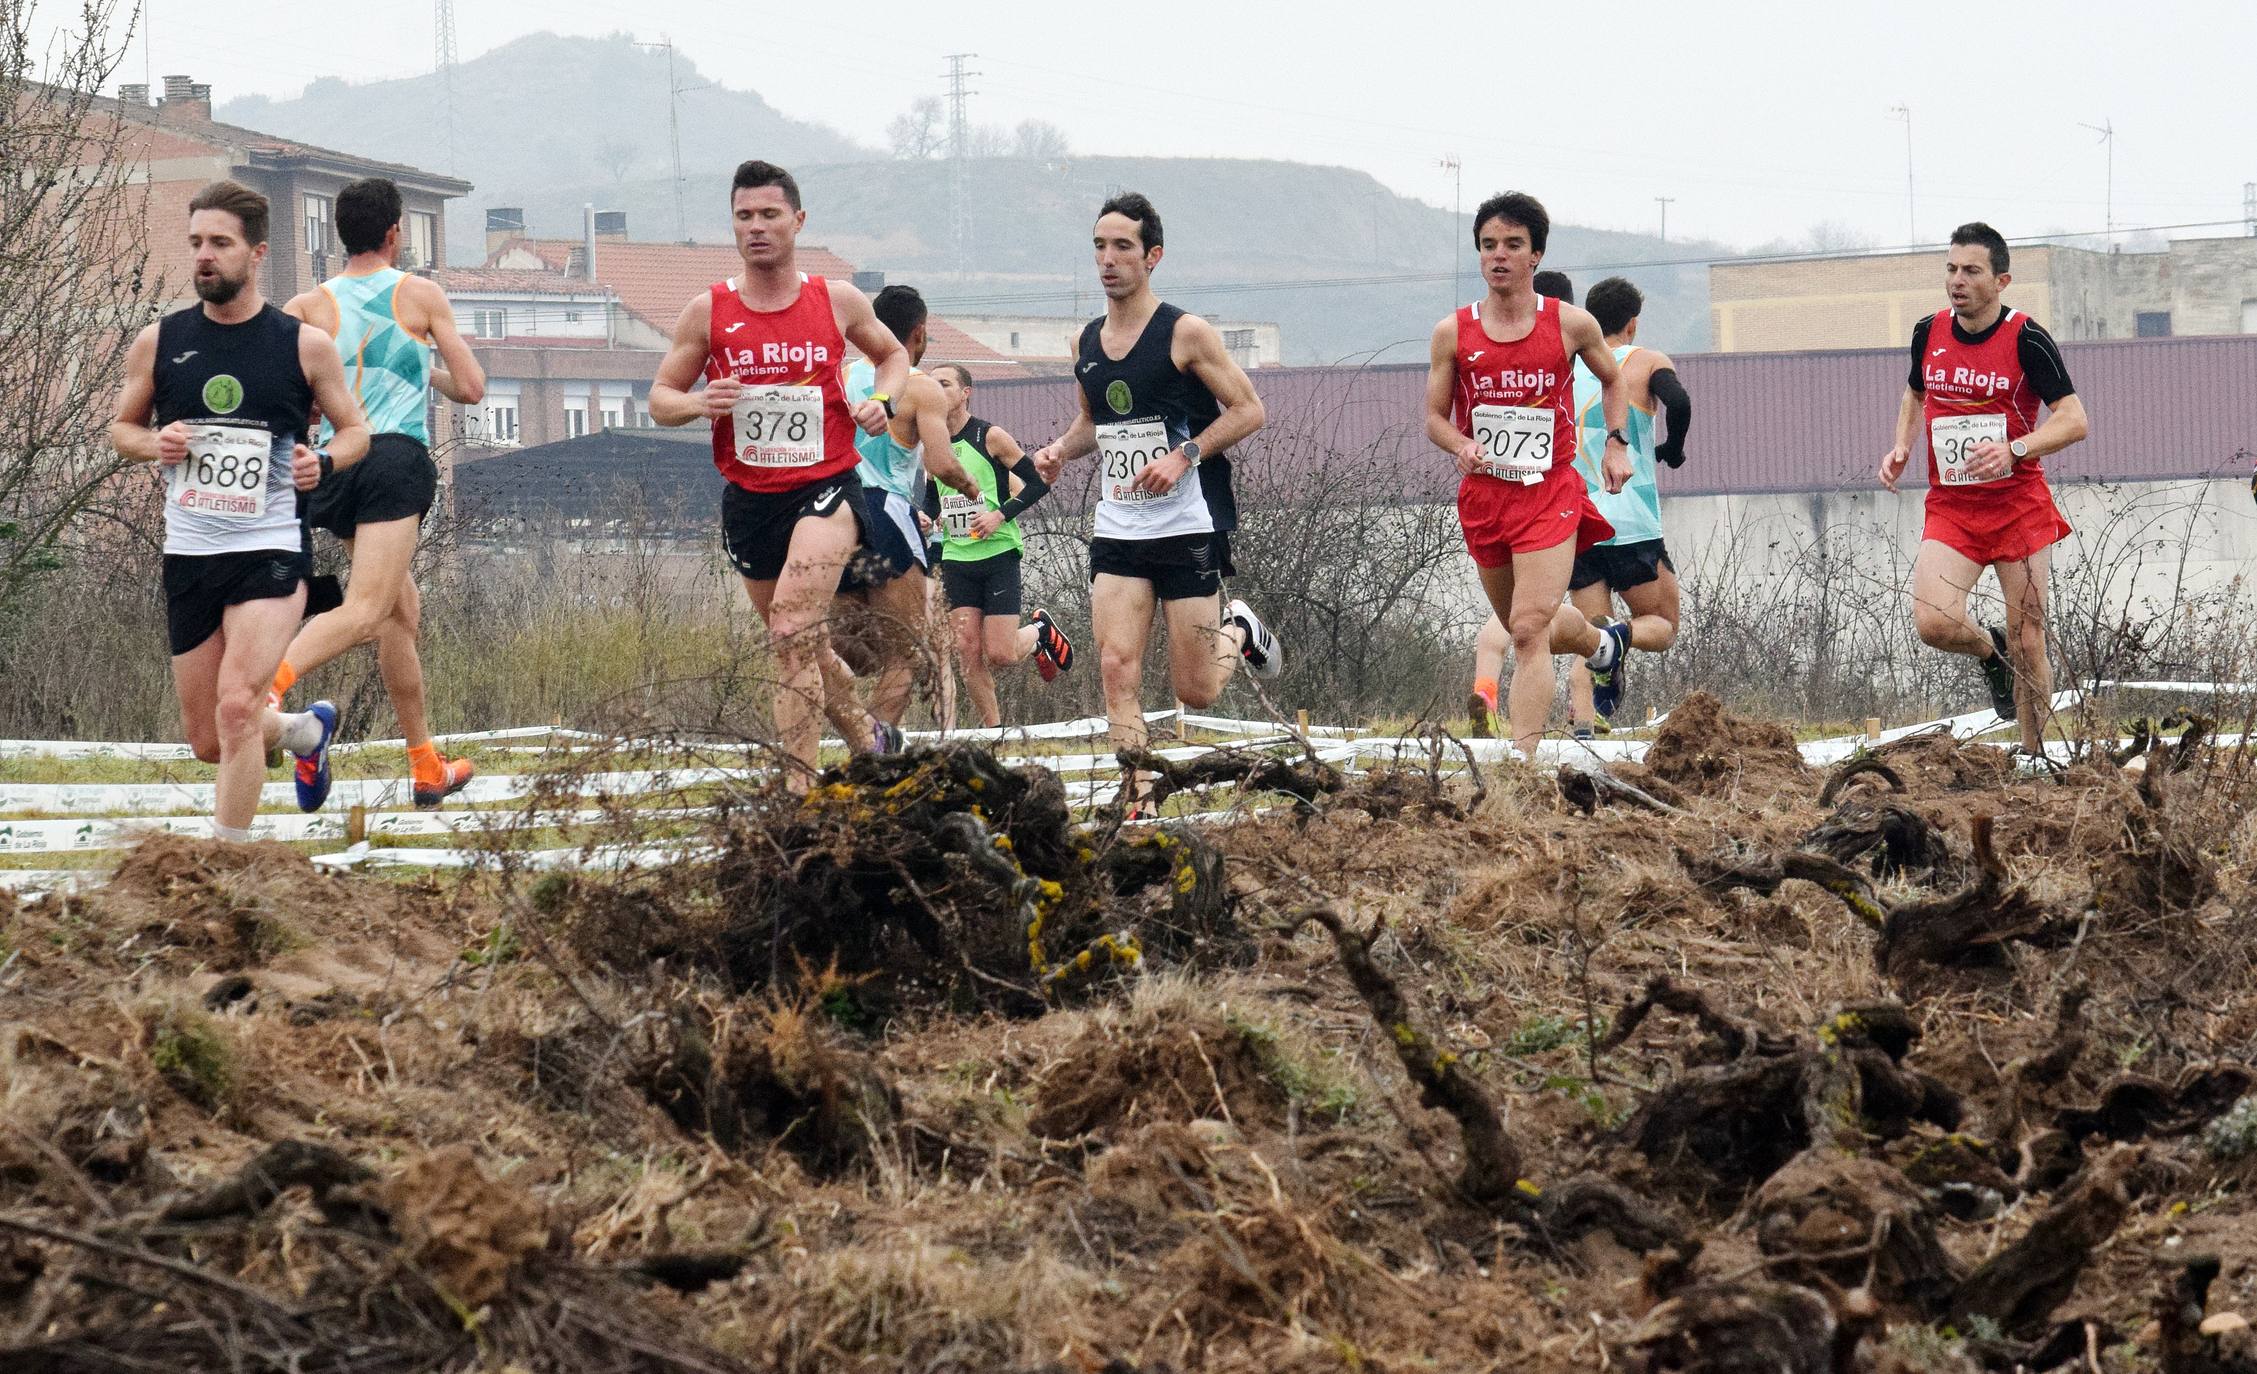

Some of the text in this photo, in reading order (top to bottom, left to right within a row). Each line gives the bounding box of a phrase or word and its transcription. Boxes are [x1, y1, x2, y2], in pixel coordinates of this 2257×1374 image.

[725, 341, 828, 373] La Rioja
[733, 365, 789, 377] tletismo
[1470, 368, 1556, 396] La Rioja
[1926, 364, 2010, 397] La Rioja
[746, 411, 807, 441] 378
[1476, 427, 1552, 460] 2073
[1945, 436, 1993, 464] 36
[183, 451, 262, 489] 1688
[760, 452, 817, 464] ATLETISMO
[199, 498, 256, 514] ATLETISMO
[947, 511, 978, 529] 77
